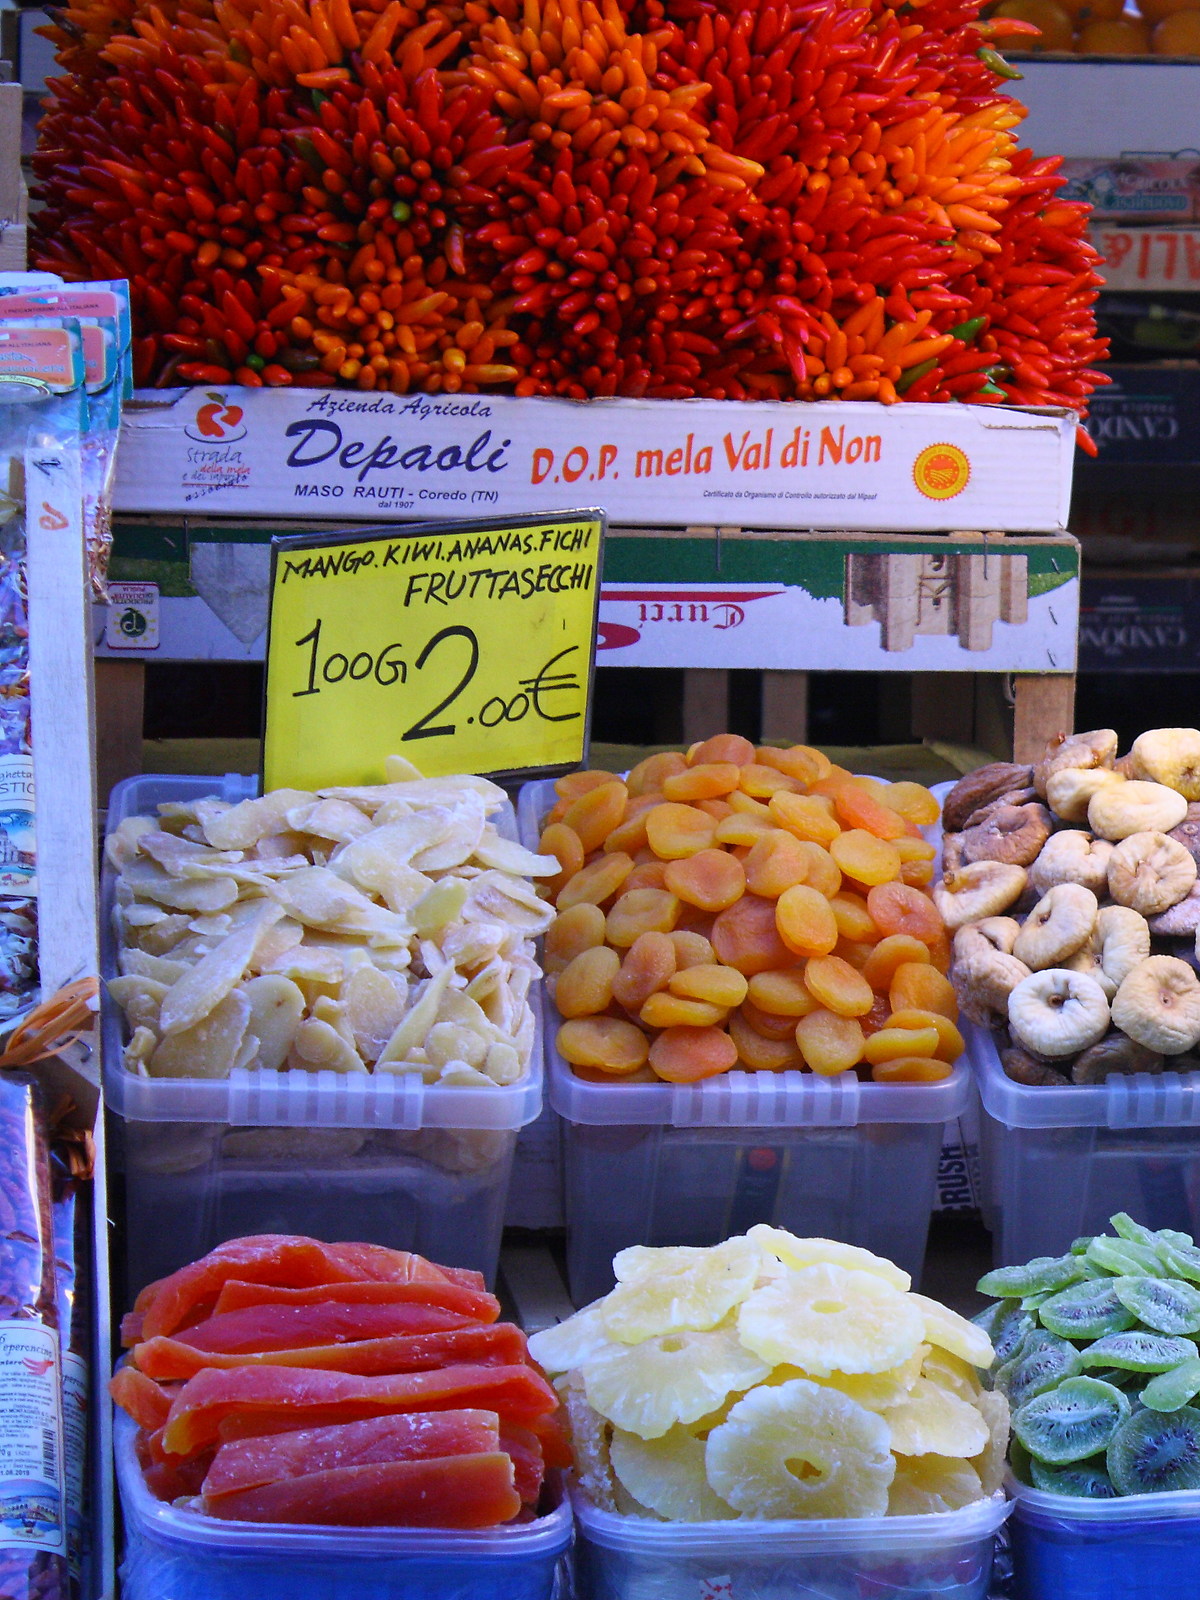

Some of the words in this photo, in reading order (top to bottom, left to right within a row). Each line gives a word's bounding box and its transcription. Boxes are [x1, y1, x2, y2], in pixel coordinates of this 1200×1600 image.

[306, 394, 396, 418] Azienda
[398, 396, 492, 418] Agricola
[187, 446, 243, 464] Strada
[285, 419, 512, 483] Depaoli
[530, 444, 618, 484] D.O.P.
[634, 432, 714, 478] mela
[721, 428, 774, 473] Val
[781, 427, 810, 468] di
[819, 424, 882, 466] Non
[294, 484, 344, 498] MASO
[354, 485, 405, 499] RAUTI
[418, 488, 467, 501] Coredo
[471, 489, 499, 503] (TN)
[378, 500, 392, 508] dal
[393, 501, 414, 509] 1907
[703, 489, 734, 498] Certificato
[744, 490, 776, 500] Organismo
[785, 491, 812, 499] Controllo
[638, 603, 745, 629] Curci
[292, 618, 407, 697] 100G
